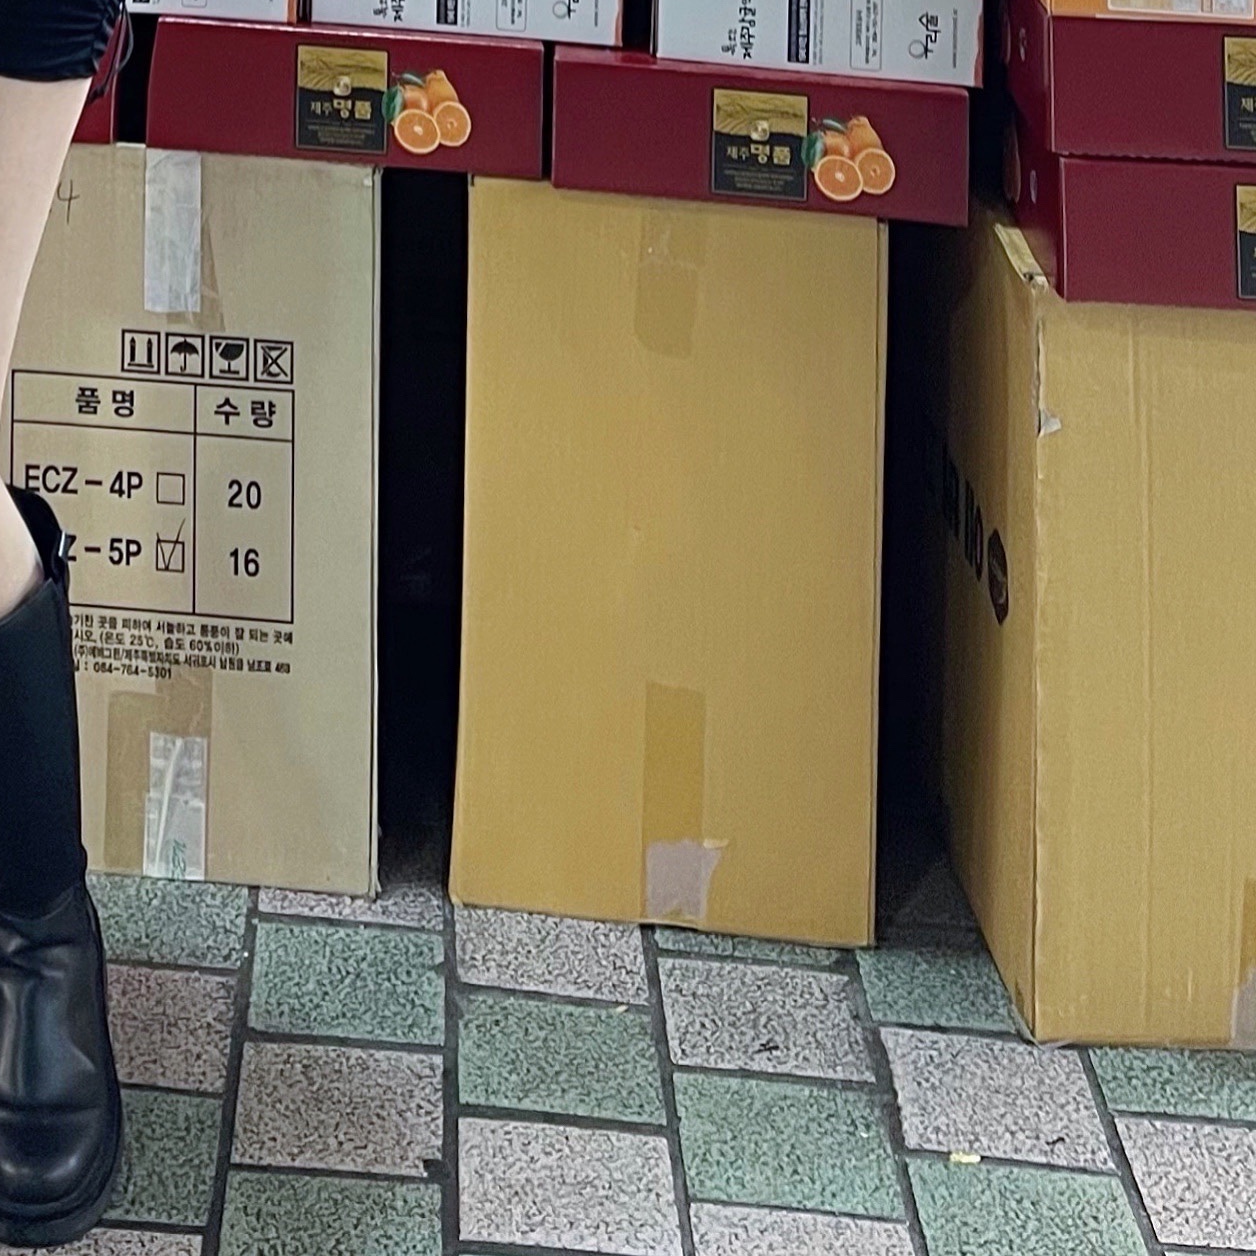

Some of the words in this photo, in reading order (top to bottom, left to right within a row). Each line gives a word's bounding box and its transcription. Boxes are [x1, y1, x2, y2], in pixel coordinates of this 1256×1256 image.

[75, 387, 136, 418] 품명
[213, 396, 276, 428] 수량
[226, 478, 263, 511] 20
[228, 547, 261, 578] 16
